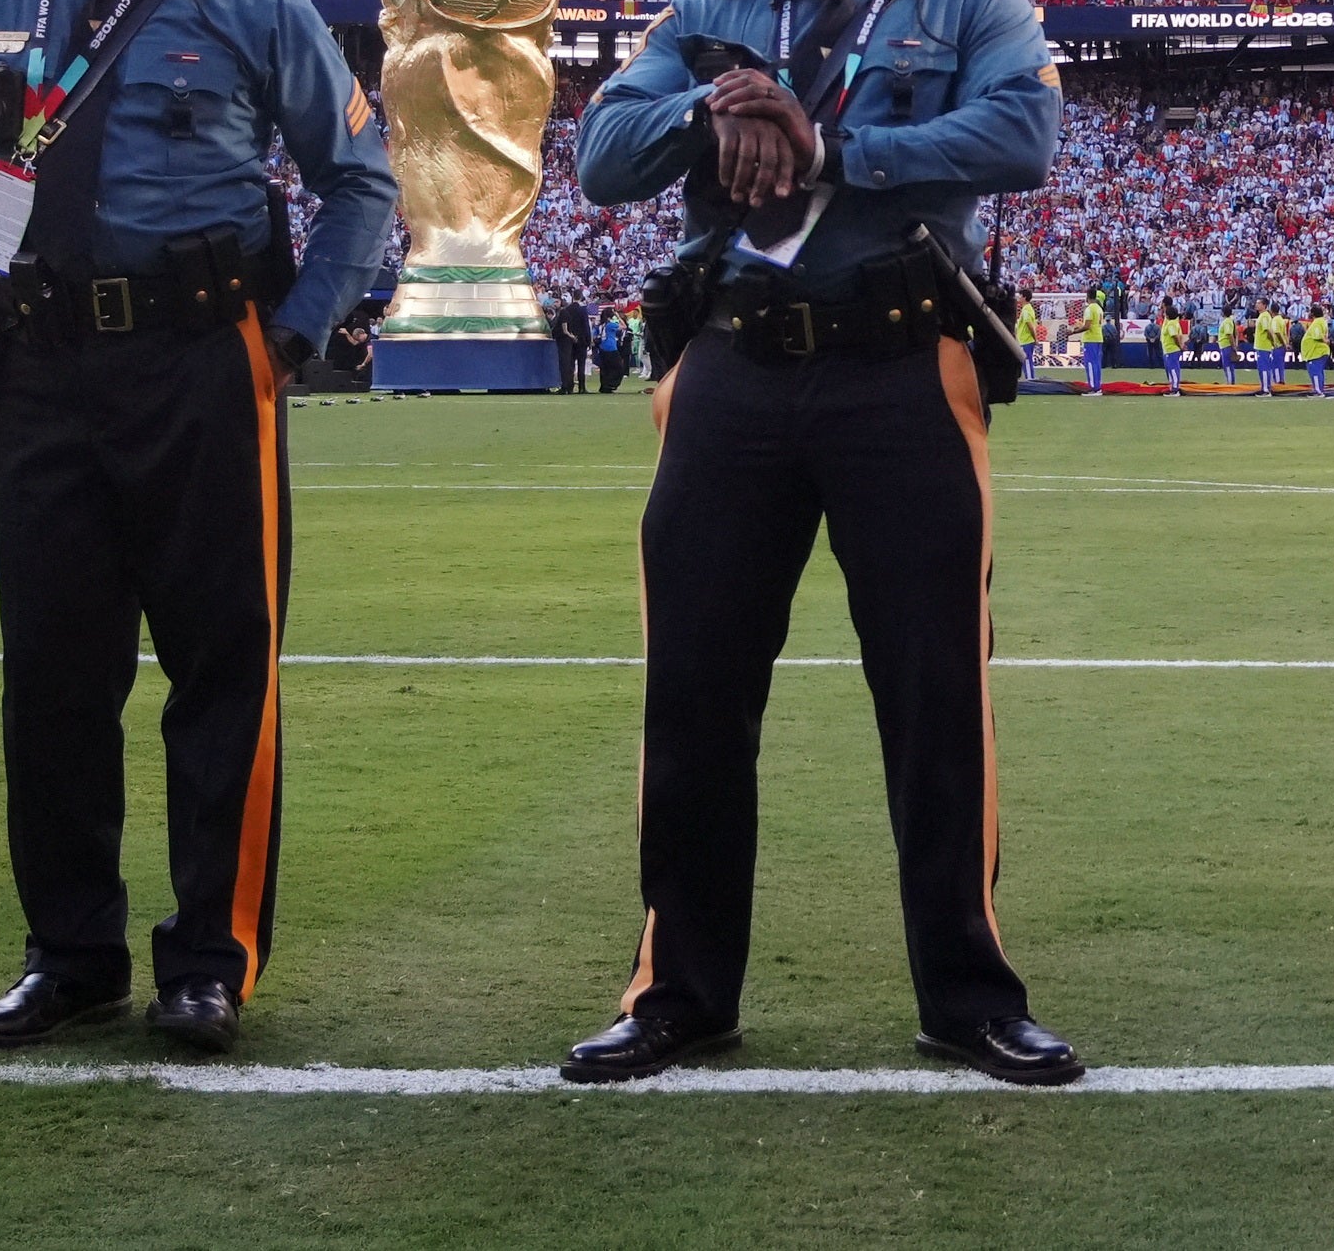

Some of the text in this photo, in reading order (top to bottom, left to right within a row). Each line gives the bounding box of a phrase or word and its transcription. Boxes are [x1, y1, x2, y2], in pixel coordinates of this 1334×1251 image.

[555, 8, 608, 22] AWARD
[780, 10, 791, 40] WORLD
[1131, 13, 1168, 29] FIFA
[1170, 13, 1233, 29] WORLD
[1235, 13, 1270, 28] CUP
[1272, 12, 1333, 28] 2026
[35, 18, 48, 39] FIFA
[90, 15, 117, 50] 2026
[780, 40, 790, 59] FIFA
